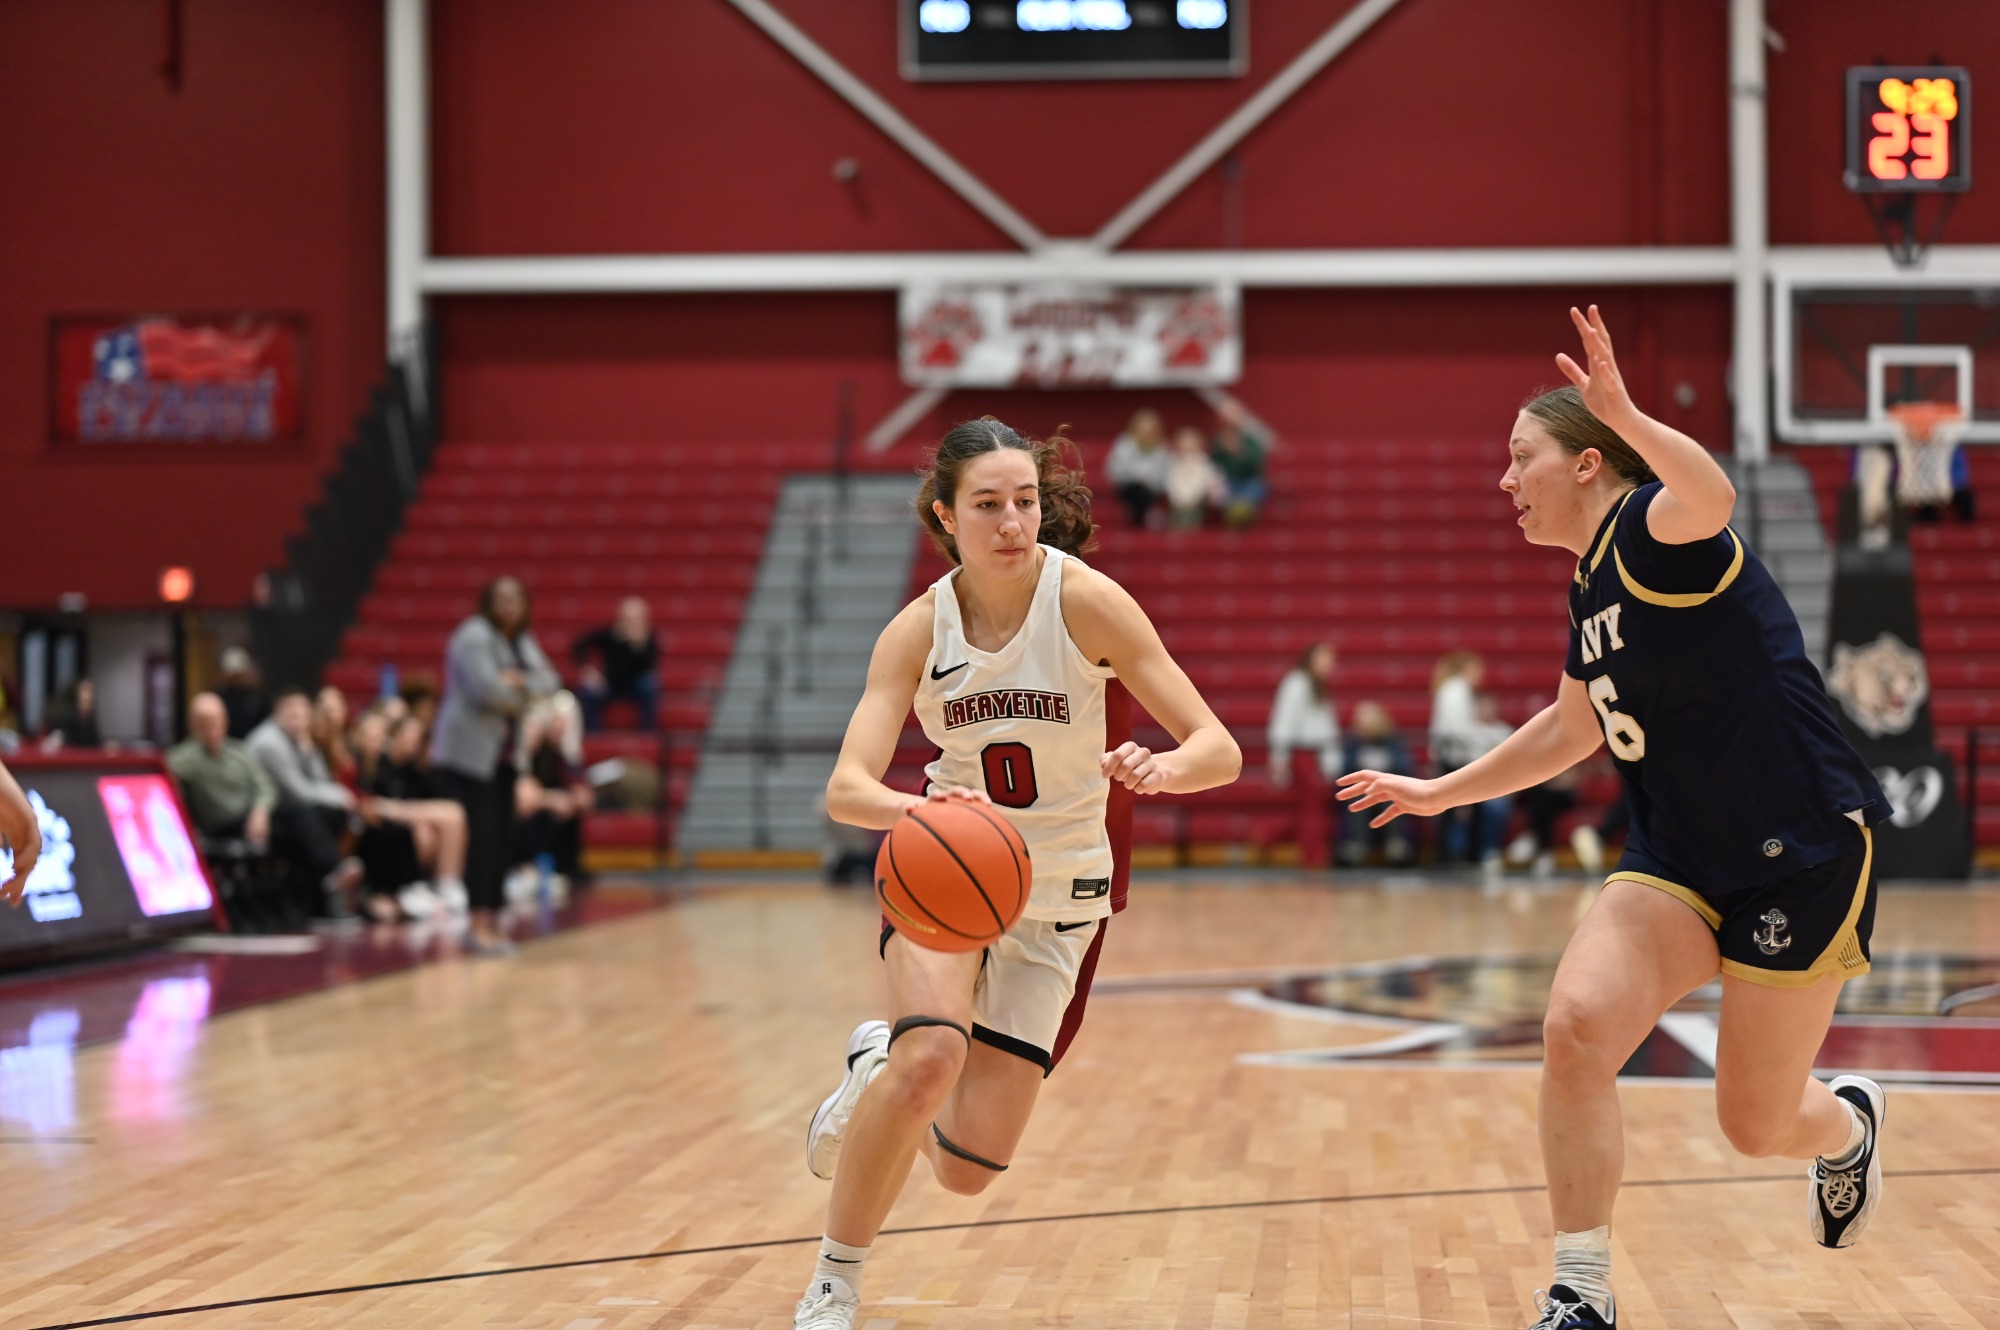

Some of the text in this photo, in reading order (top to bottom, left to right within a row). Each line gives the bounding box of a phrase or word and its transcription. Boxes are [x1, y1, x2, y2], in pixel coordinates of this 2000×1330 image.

[1869, 113, 1949, 179] 23
[943, 689, 1071, 731] LAFAYETTE
[1588, 674, 1645, 762] 6
[980, 741, 1038, 809] 0
[1100, 884, 1107, 893] M
[1764, 916, 1784, 924] NAVY
